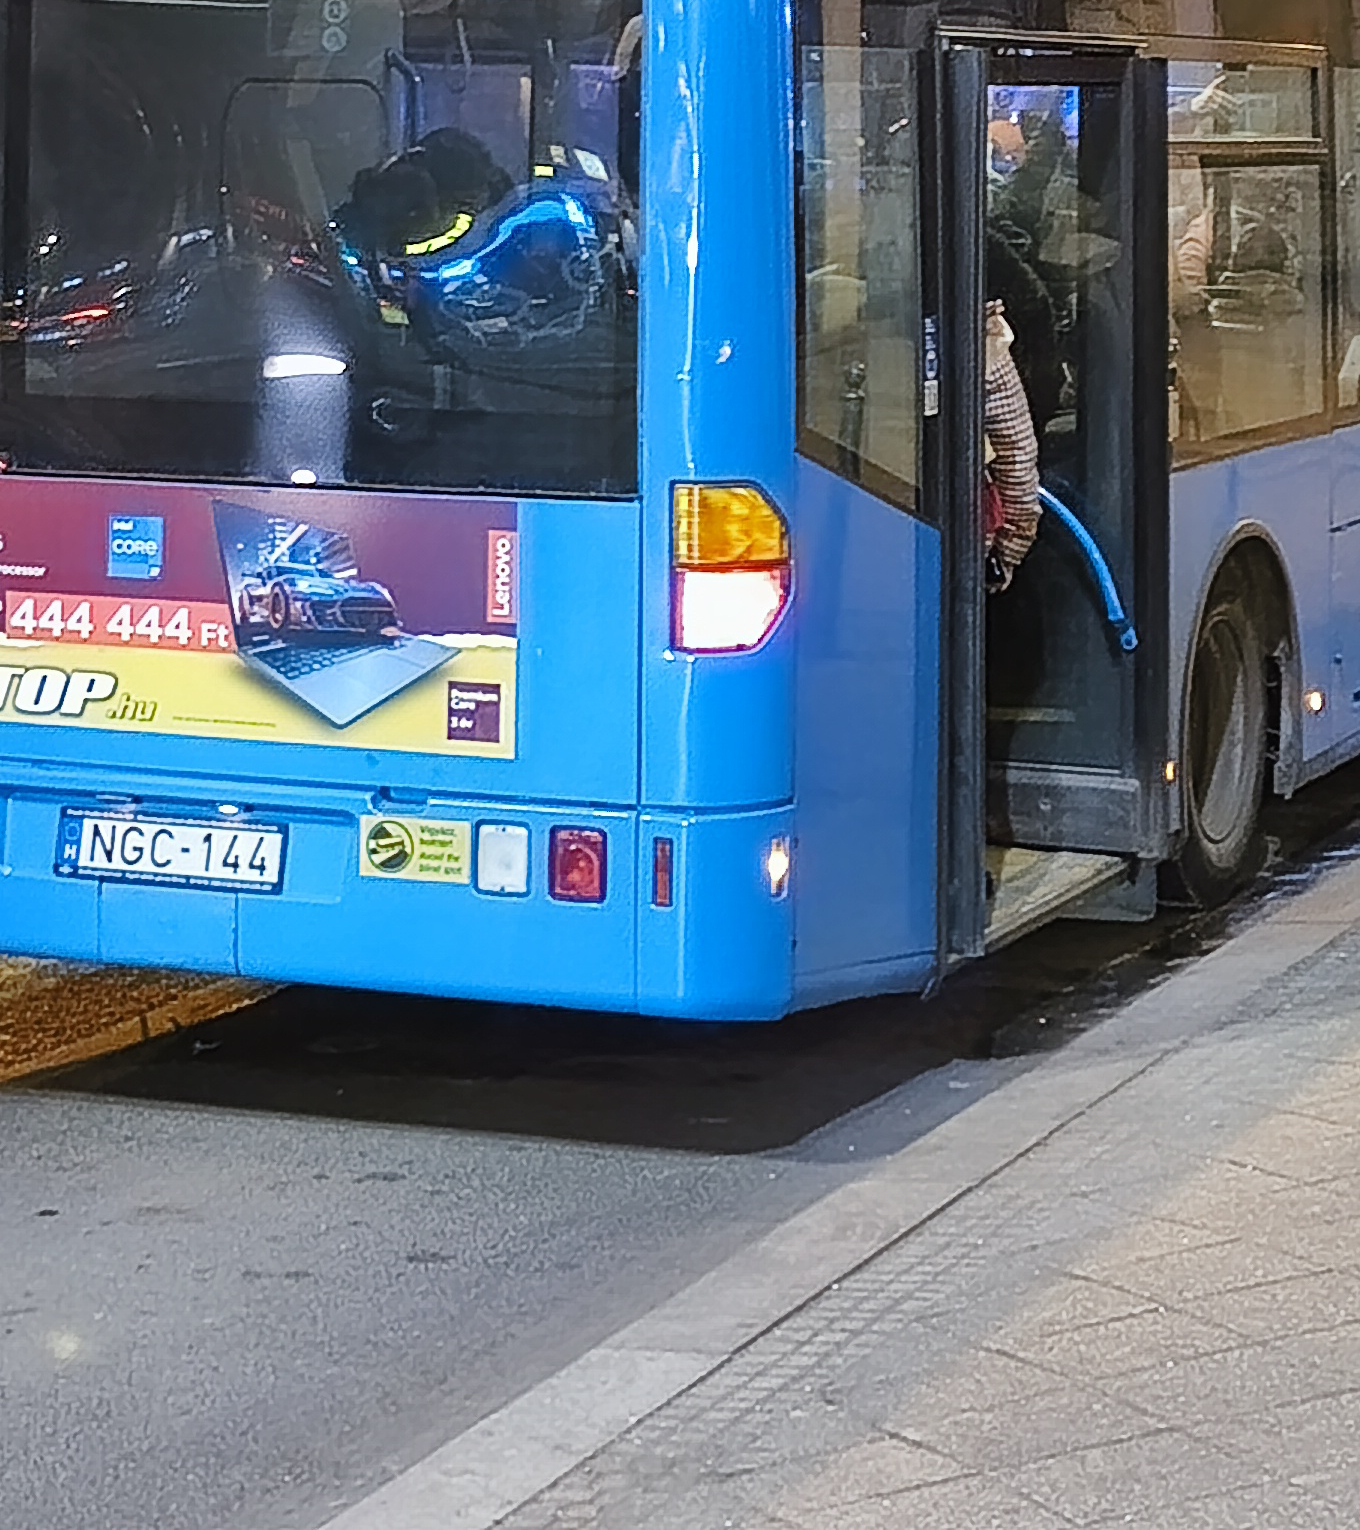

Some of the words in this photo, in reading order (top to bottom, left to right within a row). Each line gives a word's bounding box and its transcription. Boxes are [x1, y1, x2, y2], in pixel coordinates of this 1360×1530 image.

[492, 537, 511, 617] Lenovo
[10, 598, 94, 639] 444
[107, 603, 192, 646] 444
[200, 622, 230, 648] Ft
[63, 844, 77, 860] H
[89, 823, 267, 877] NGC-144
